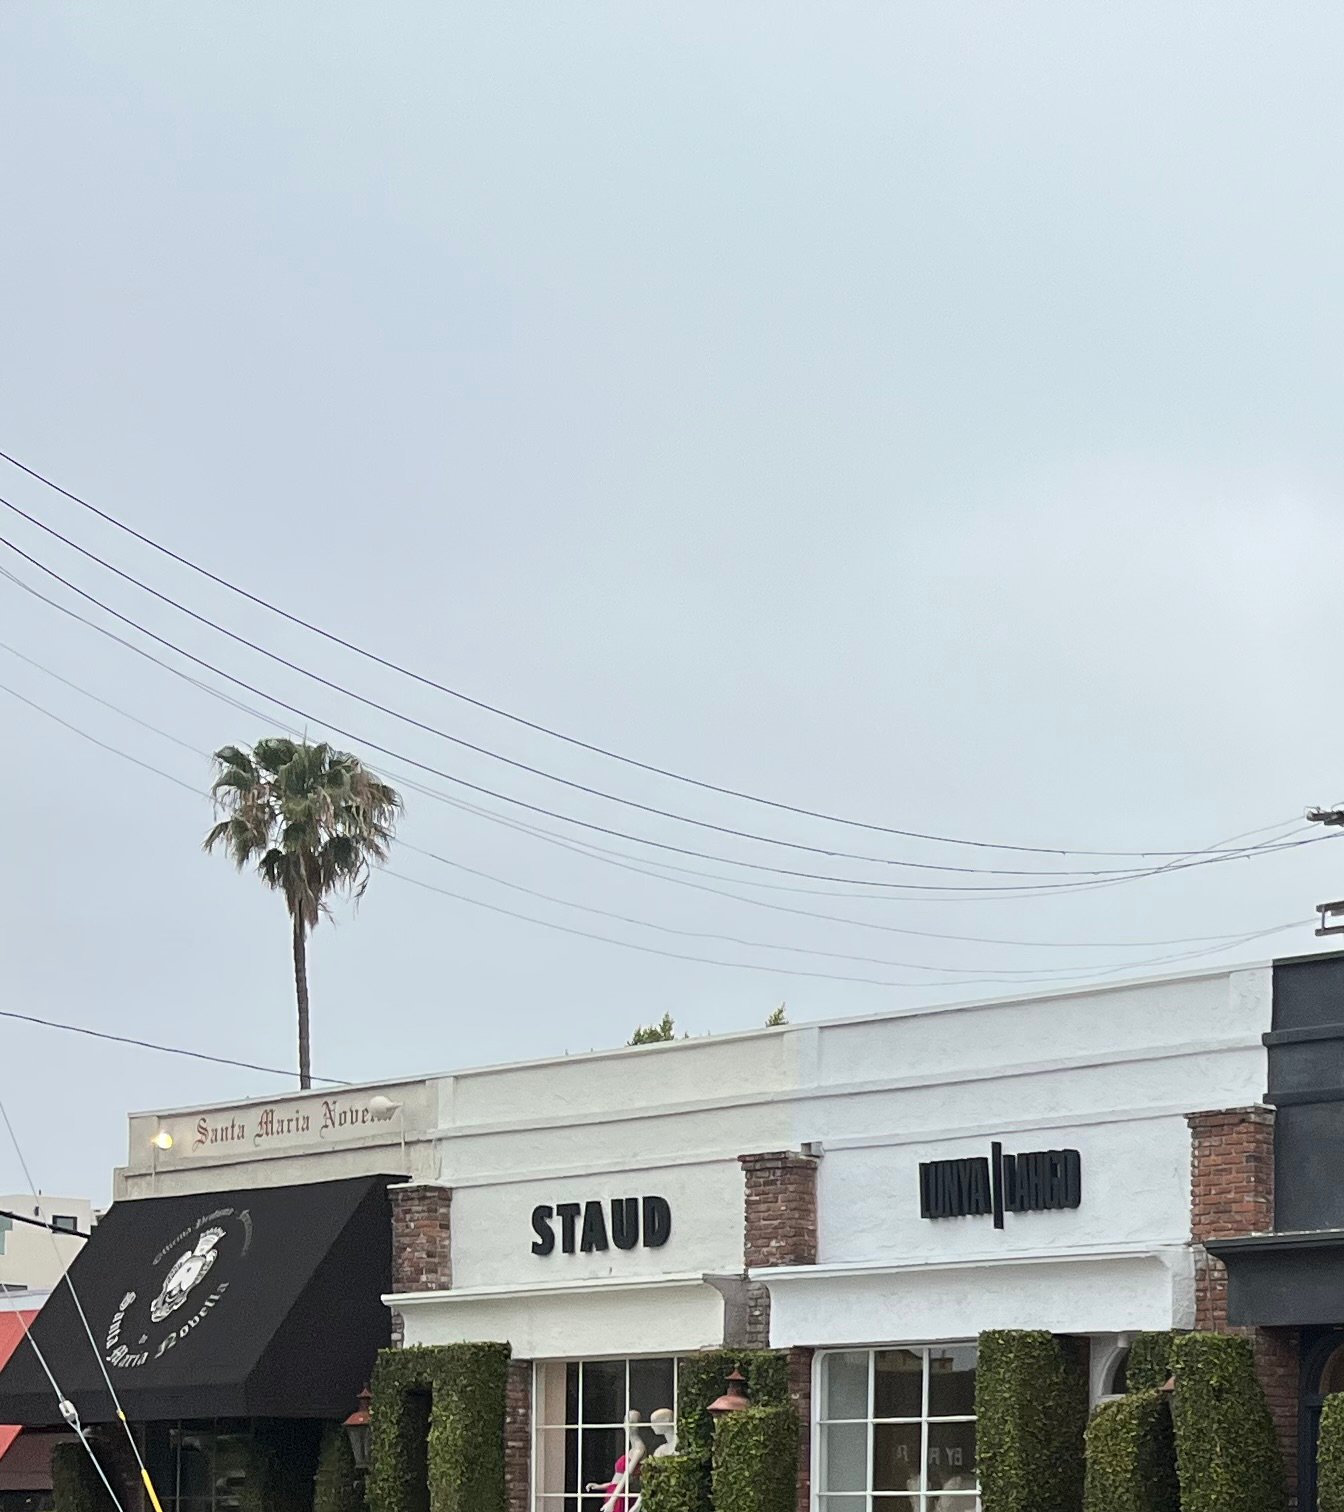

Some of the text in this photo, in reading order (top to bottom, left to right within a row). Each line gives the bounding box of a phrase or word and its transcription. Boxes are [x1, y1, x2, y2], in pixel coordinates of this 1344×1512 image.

[192, 1117, 246, 1151] Santa
[254, 1109, 310, 1147] Maria
[919, 1157, 992, 1219] LUNYA
[531, 1196, 671, 1256] STAUD
